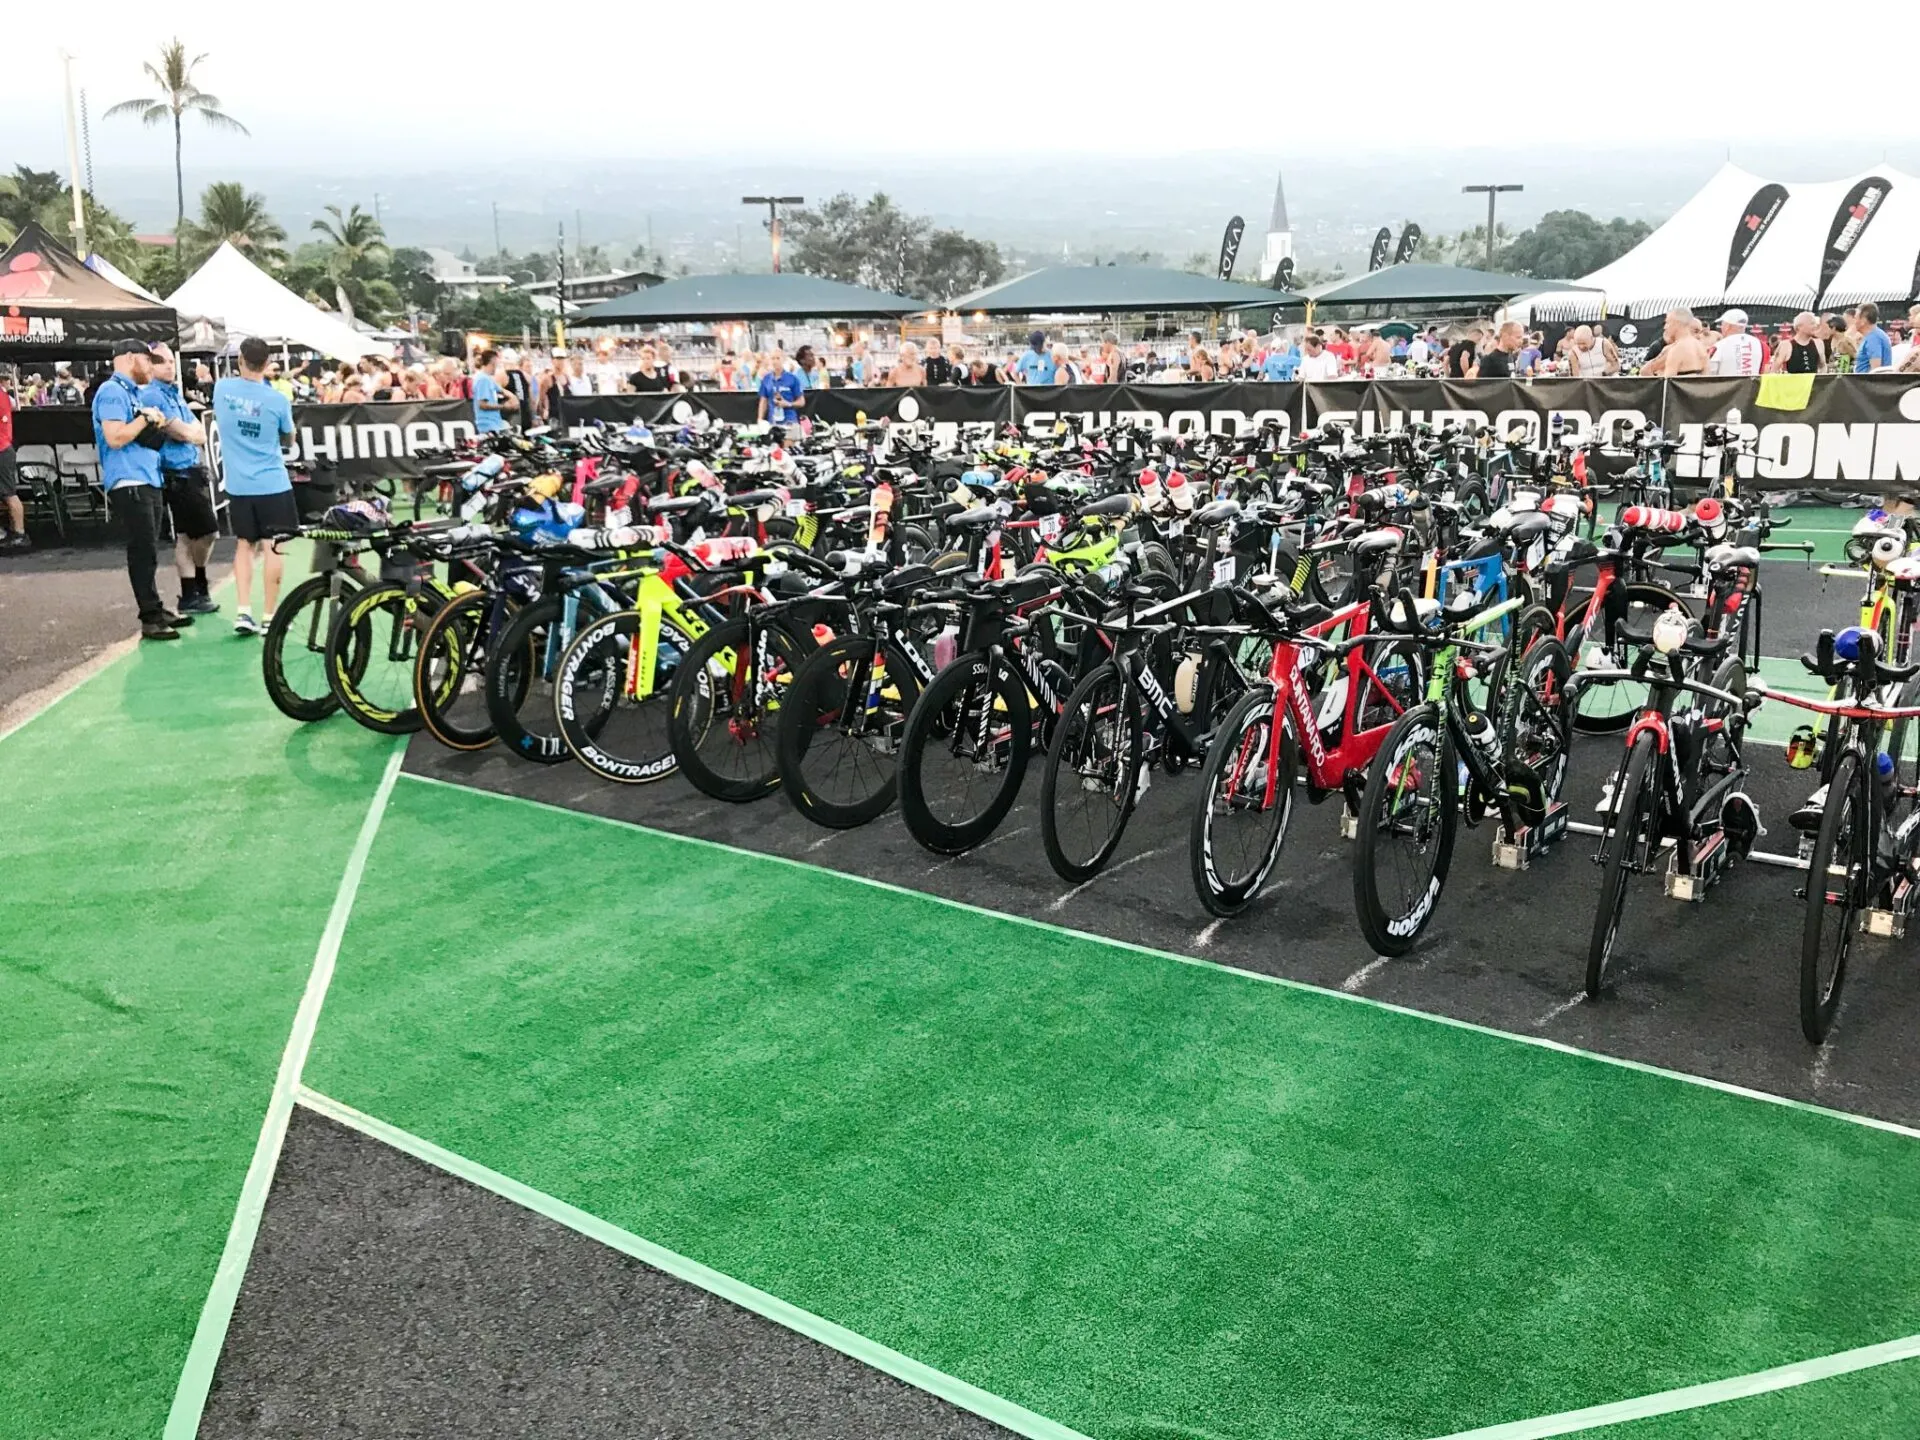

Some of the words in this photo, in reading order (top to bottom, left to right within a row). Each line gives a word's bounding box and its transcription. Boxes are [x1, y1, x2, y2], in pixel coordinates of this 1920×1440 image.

[1833, 186, 1883, 252] IRONMAN
[561, 622, 616, 721] BONTRAGER
[1137, 664, 1173, 720] BMC
